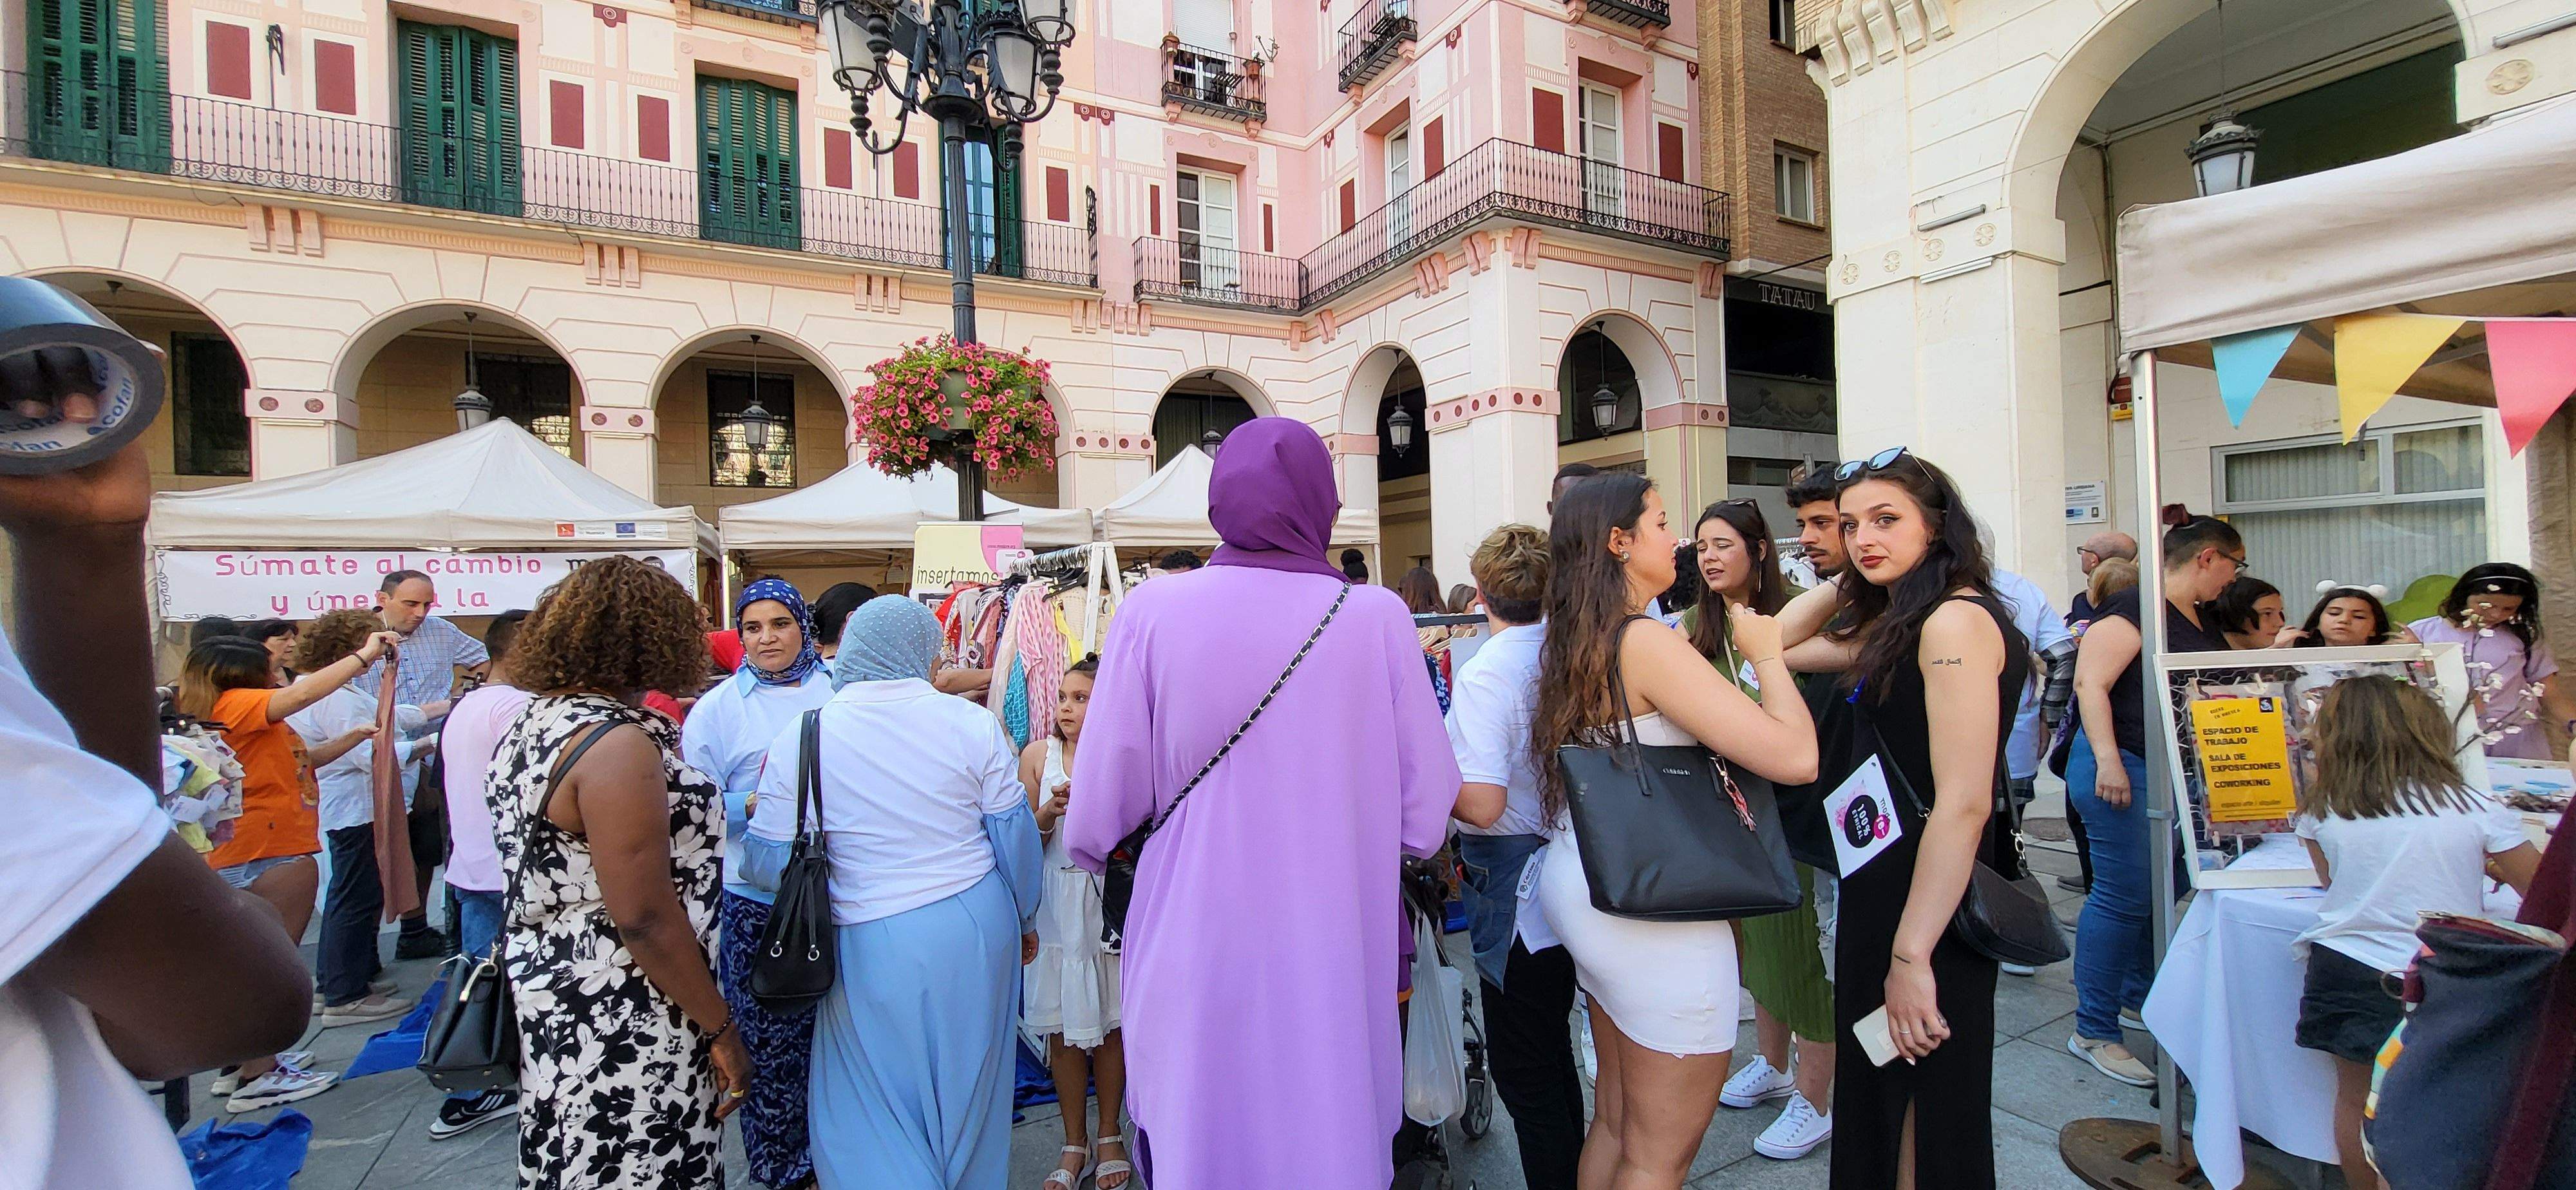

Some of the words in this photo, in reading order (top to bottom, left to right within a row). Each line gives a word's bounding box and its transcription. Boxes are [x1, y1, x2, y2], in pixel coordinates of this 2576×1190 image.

[1758, 283, 1815, 310] TATAU
[102, 377, 132, 425] cofan
[216, 554, 358, 576] Súmate
[376, 554, 405, 575] al
[426, 555, 542, 574] cambio
[270, 595, 289, 616] y
[457, 588, 489, 607] la
[2202, 727, 2242, 735] ESPACIO
[2204, 737, 2248, 746] TRABAJO
[2211, 762, 2282, 773] EXPOSICIONES
[2213, 779, 2271, 788] COWORKING
[1852, 809, 1863, 840] ETHICAL
[1857, 803, 1871, 836] 100%
